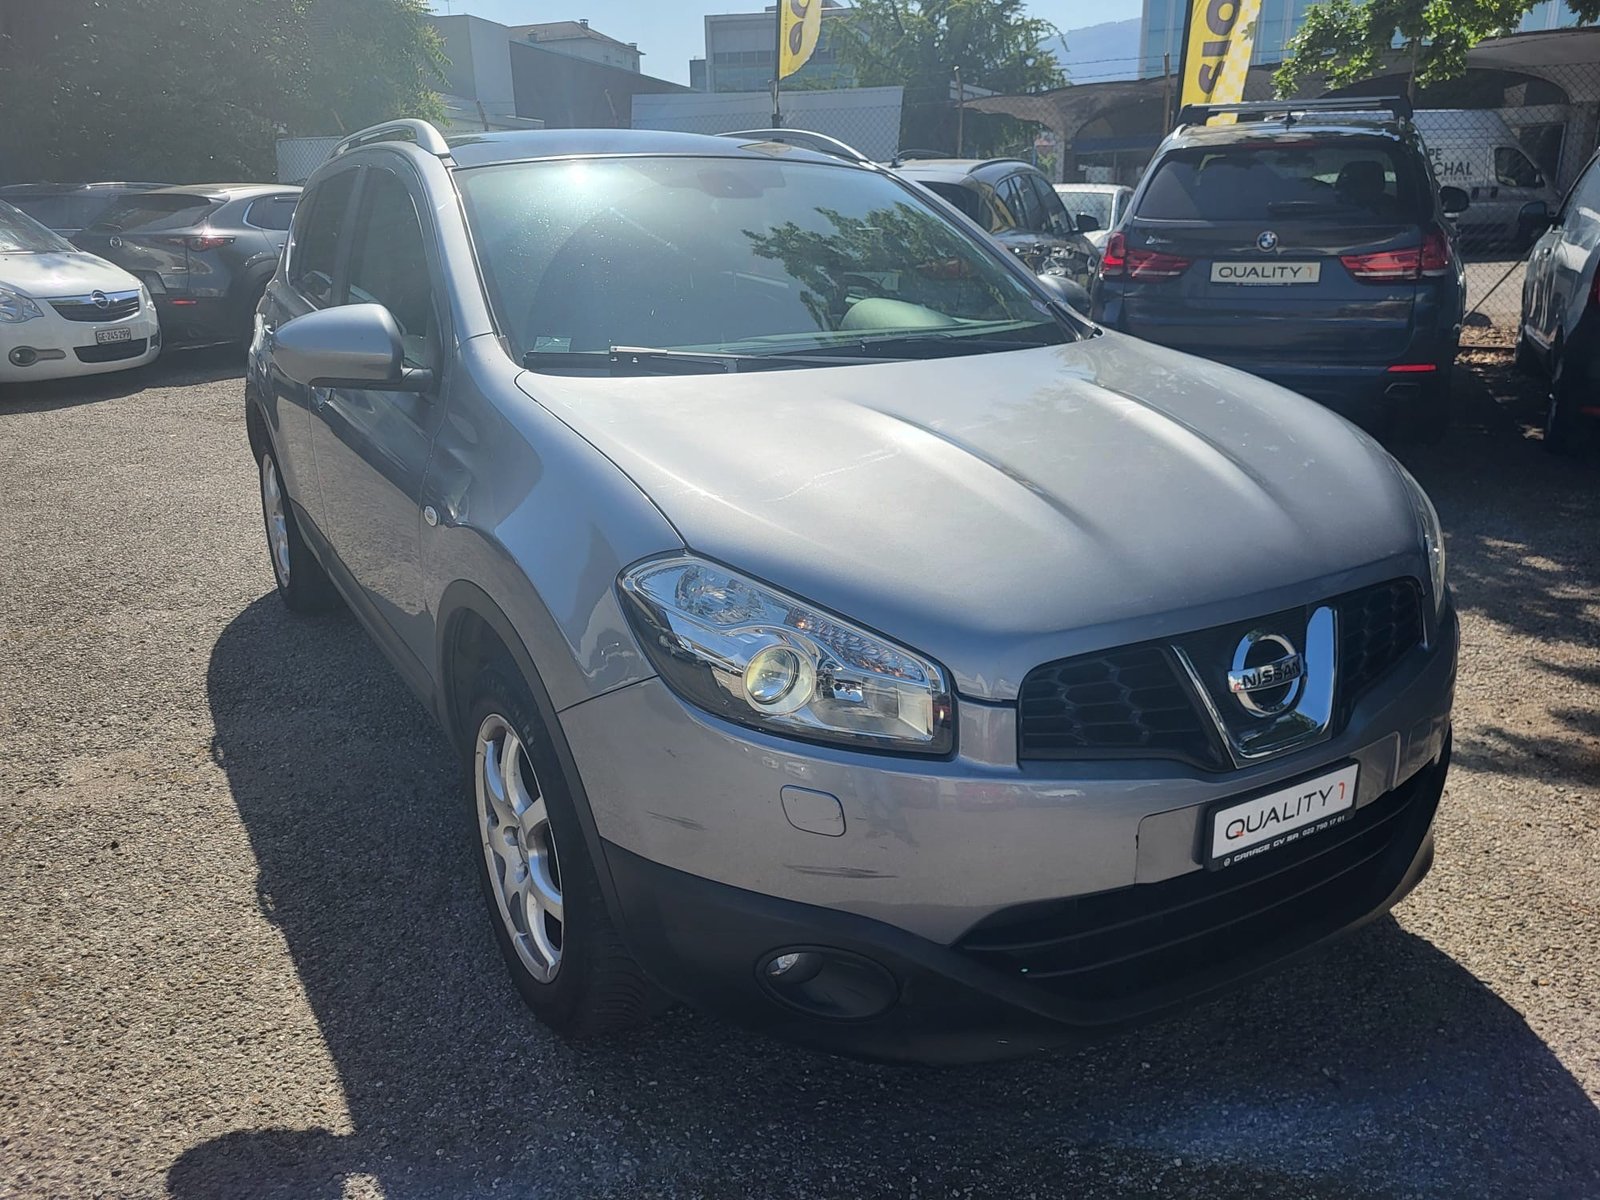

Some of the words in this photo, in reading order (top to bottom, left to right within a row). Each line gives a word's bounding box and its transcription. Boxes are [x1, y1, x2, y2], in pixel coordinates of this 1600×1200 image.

[1219, 266, 1302, 278] QUALITY
[1241, 659, 1301, 688] NISSAN
[1225, 784, 1334, 840] QUALITY
[1233, 843, 1271, 863] GARAGE
